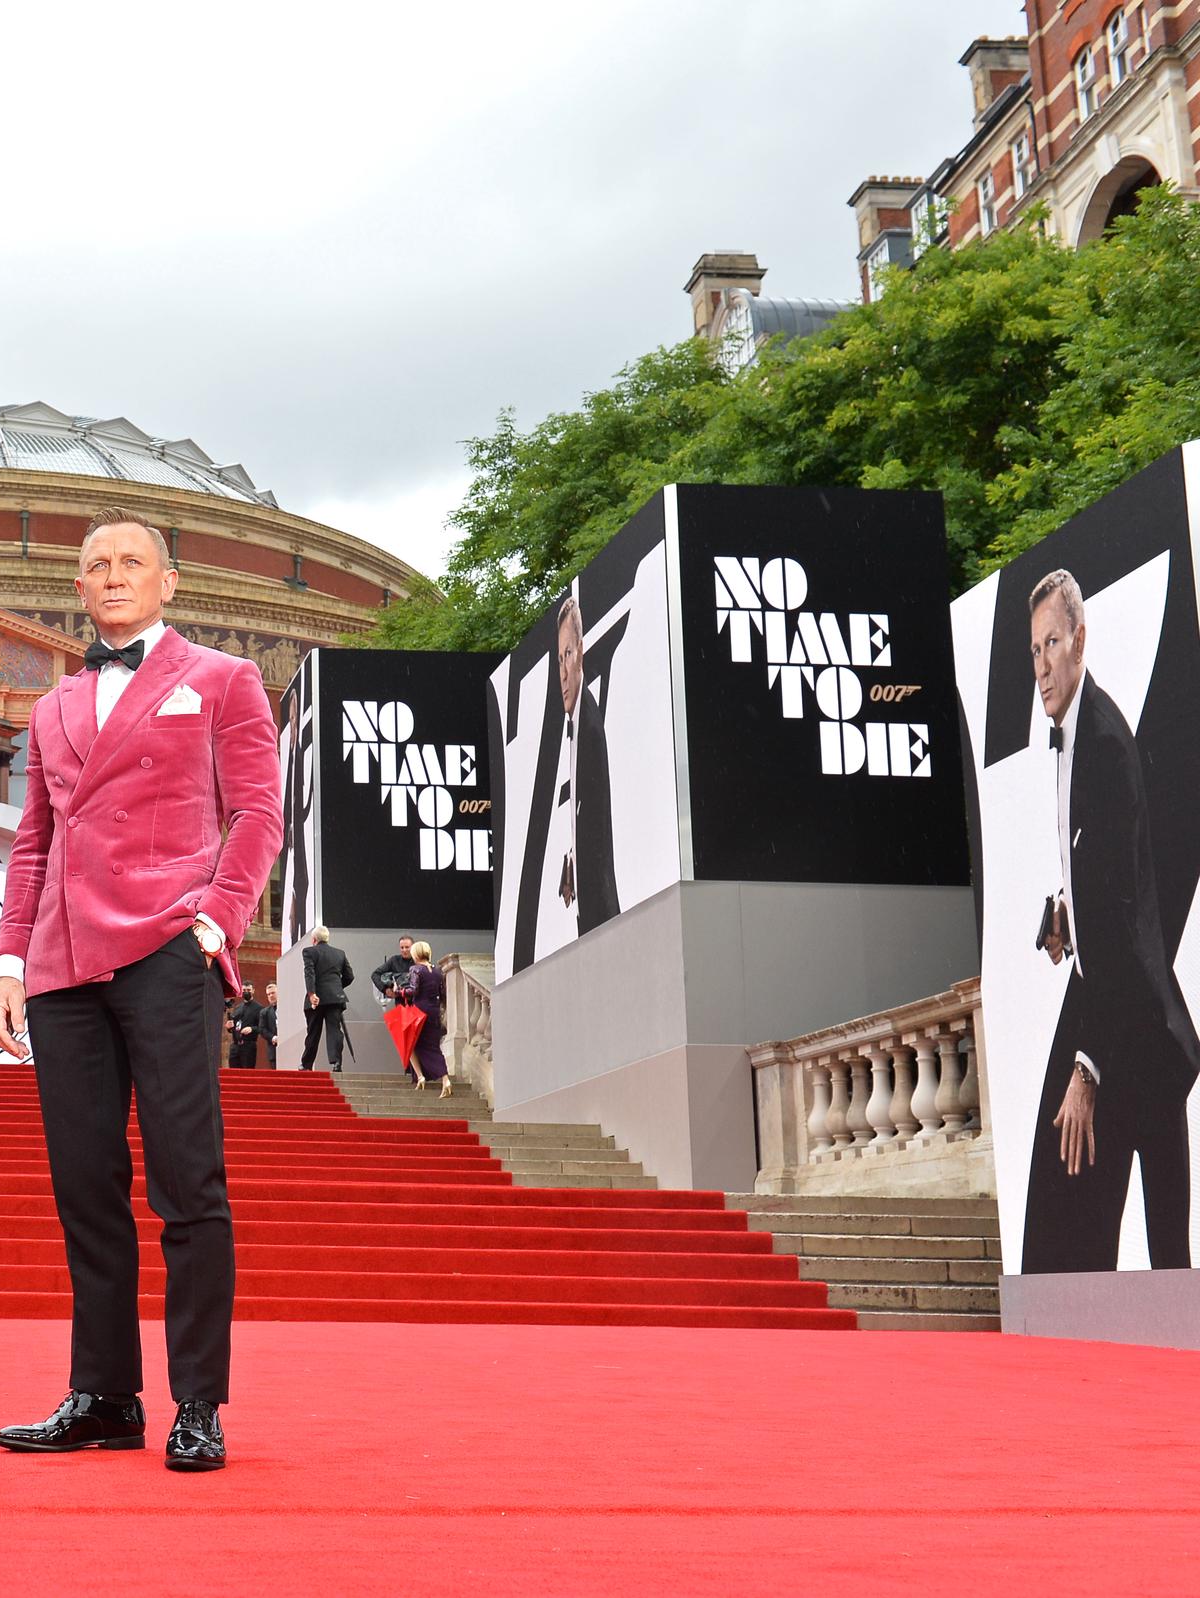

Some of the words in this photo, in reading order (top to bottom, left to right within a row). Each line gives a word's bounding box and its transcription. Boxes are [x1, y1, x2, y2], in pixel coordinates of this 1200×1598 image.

[714, 556, 807, 611] NO
[716, 609, 891, 667] TIME
[768, 665, 862, 719] TO
[869, 684, 921, 703] 007
[342, 700, 414, 743] NO
[343, 742, 477, 786] TIME
[819, 720, 932, 777] DIE
[381, 785, 454, 828] TO
[459, 799, 492, 813] 007
[419, 828, 493, 872] DIE
